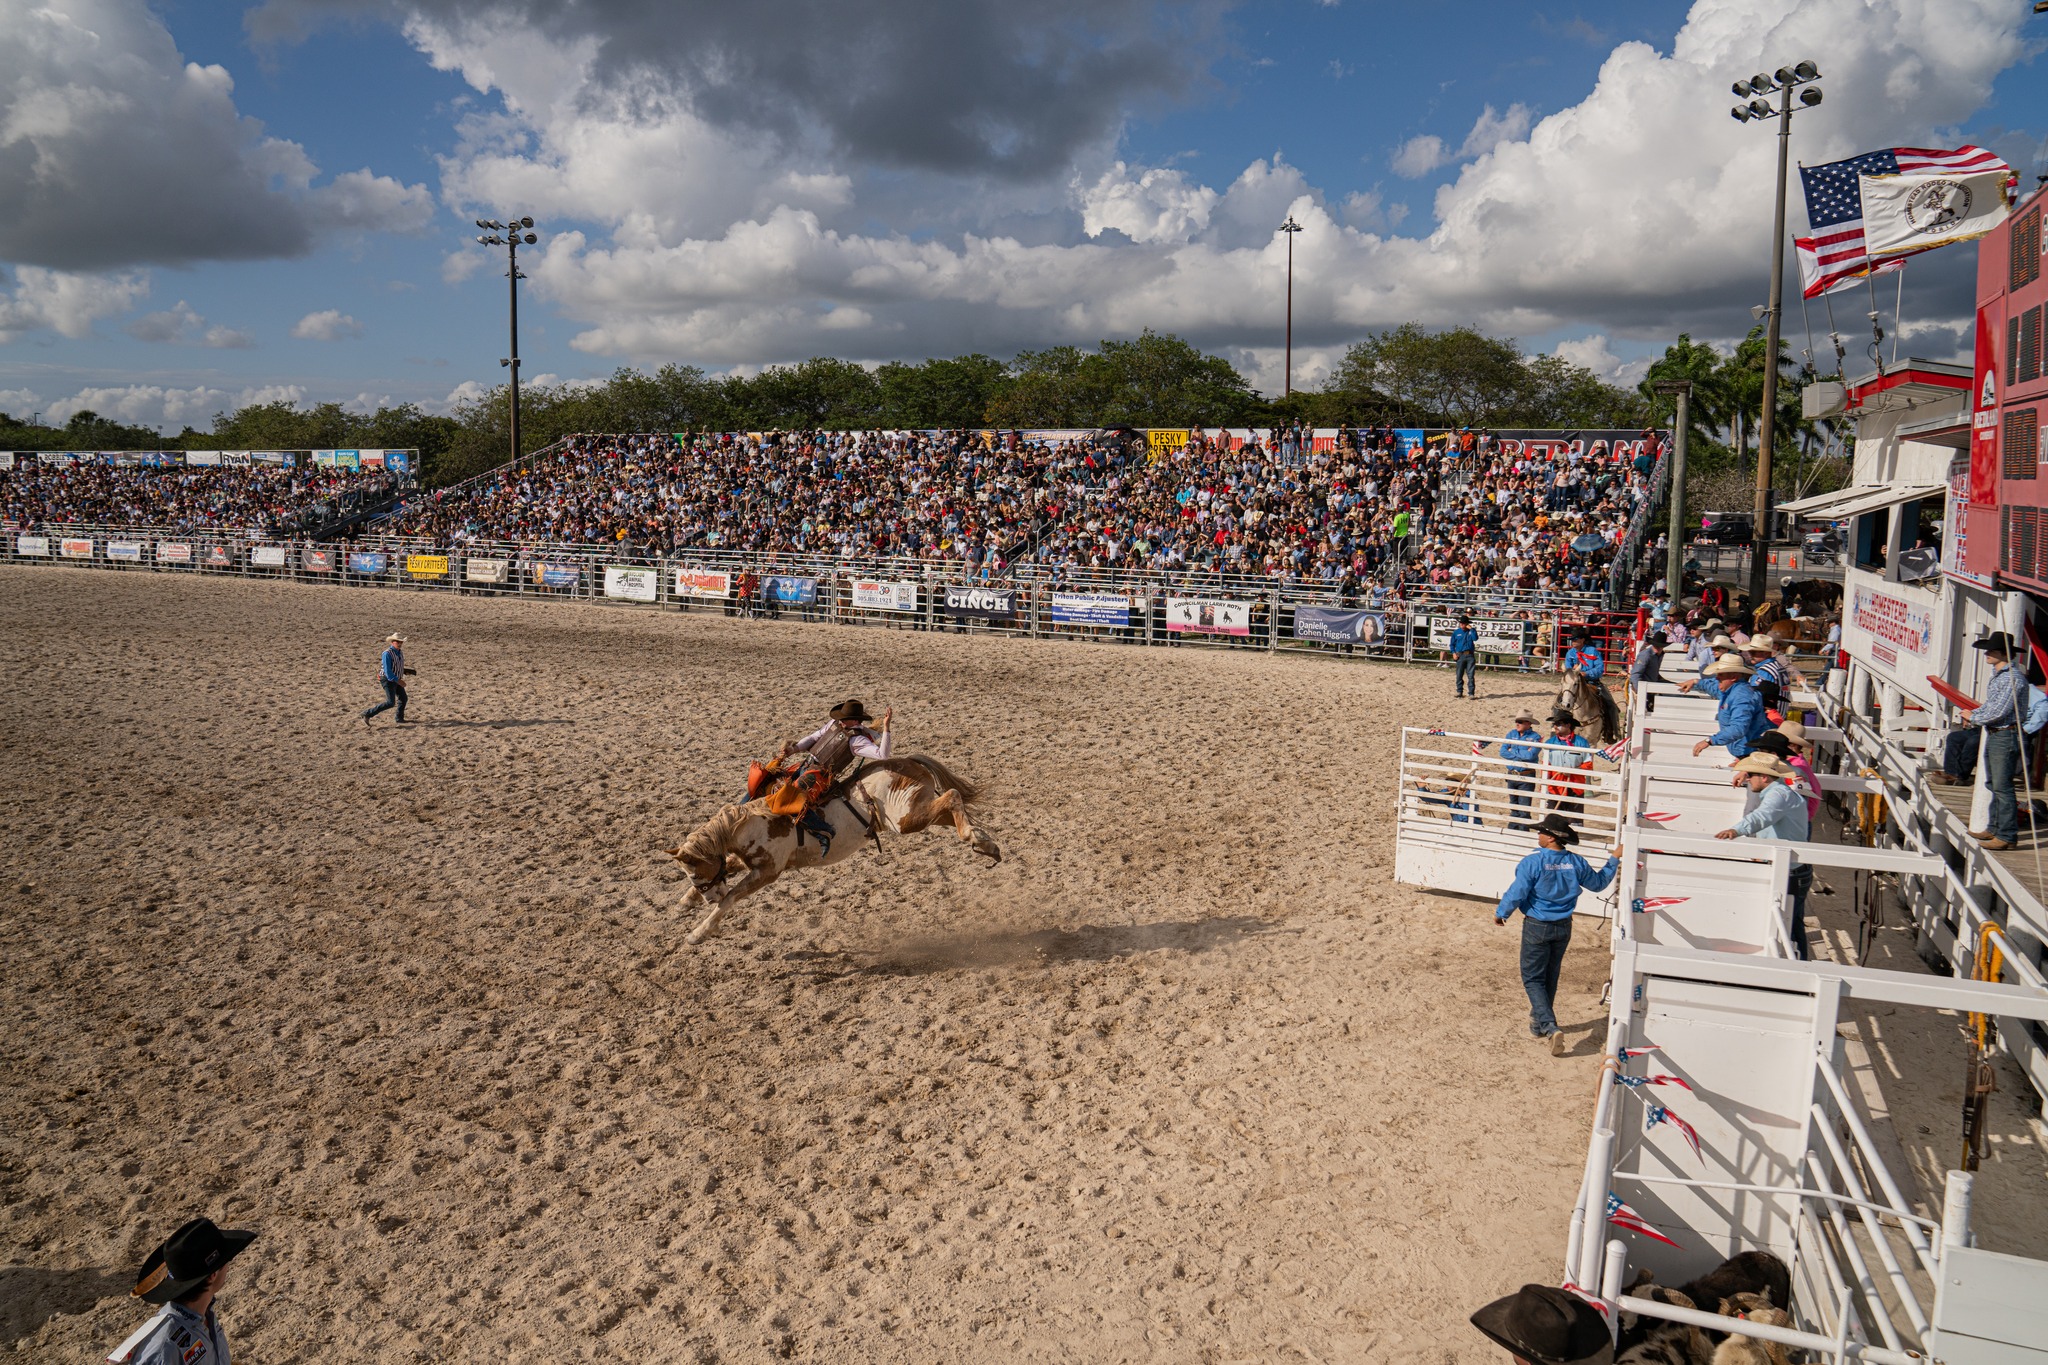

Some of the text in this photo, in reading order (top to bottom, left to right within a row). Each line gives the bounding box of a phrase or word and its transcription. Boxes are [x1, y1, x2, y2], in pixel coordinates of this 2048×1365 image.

[1154, 432, 1181, 444] PESKY
[223, 453, 250, 464] RYAN
[409, 560, 446, 570] PESKY CRITTERS
[947, 594, 1009, 611] CINCH
[1174, 600, 1208, 608] COUNCILMAN
[1870, 592, 1907, 624] HOMESTEAD
[1298, 620, 1328, 630] Danielle
[1491, 622, 1522, 632] FEED
[1858, 608, 1920, 653] RODEO ASSOCIATION
[1298, 628, 1322, 637] Cohen
[1323, 630, 1351, 640] Higgins
[187, 1345, 206, 1365] AKOTA
